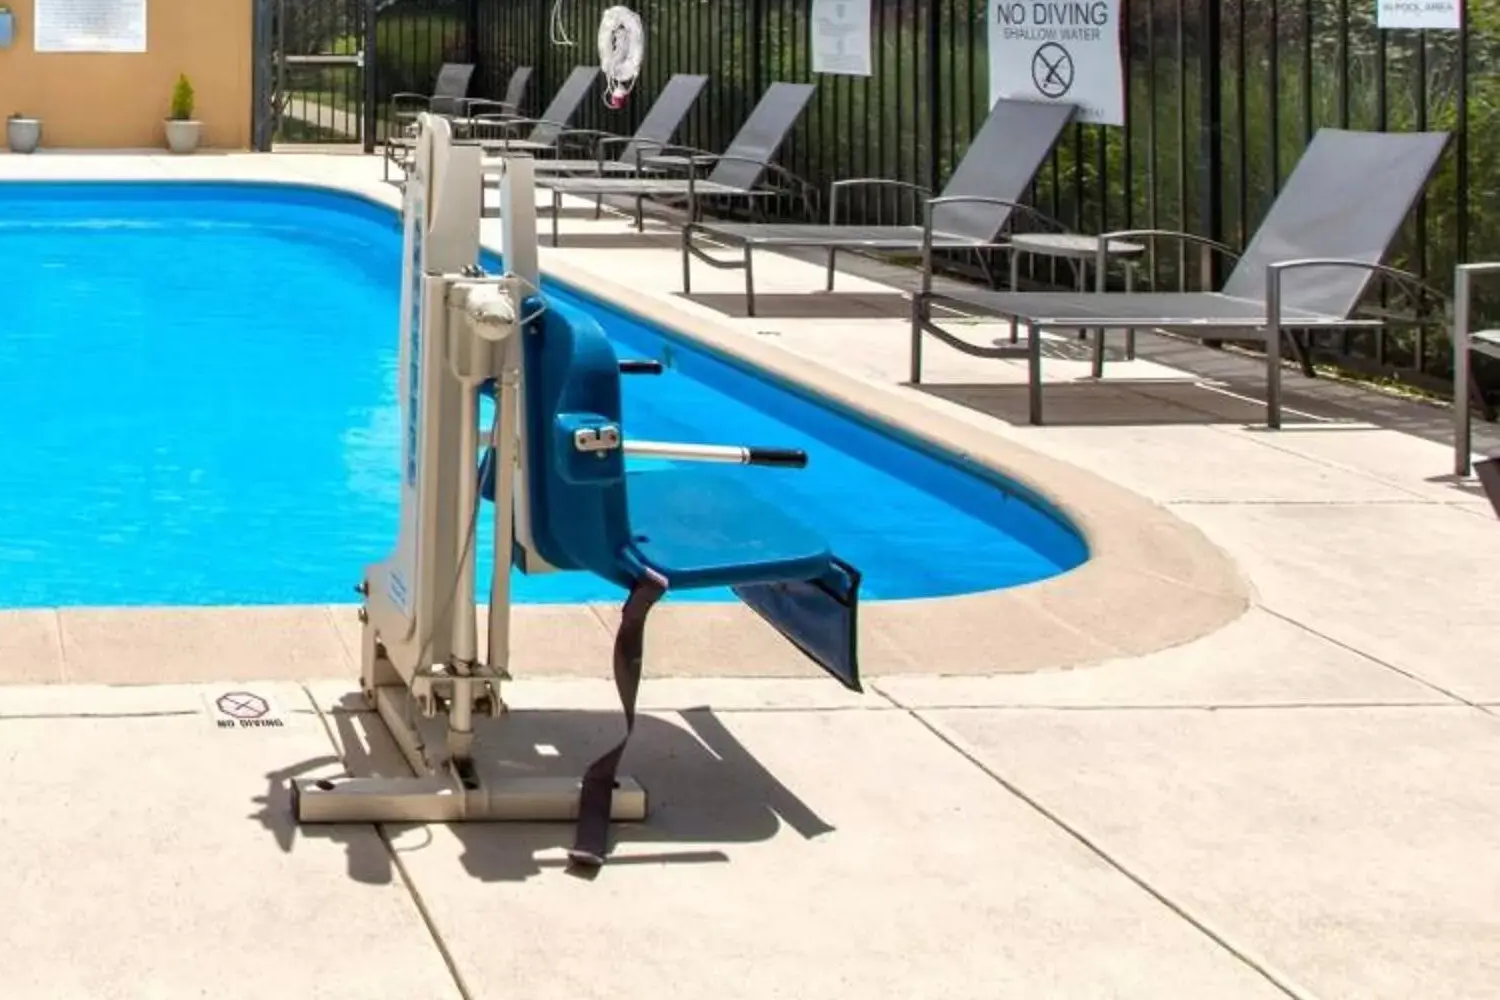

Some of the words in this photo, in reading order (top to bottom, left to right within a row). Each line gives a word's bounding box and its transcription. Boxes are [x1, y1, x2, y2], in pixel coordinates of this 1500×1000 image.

[997, 3, 1026, 24] NO
[1033, 1, 1108, 25] DIVING
[1003, 27, 1057, 39] SHALLOW
[1060, 27, 1101, 39] WATER
[217, 719, 235, 728] NO
[239, 719, 284, 728] DIVING
